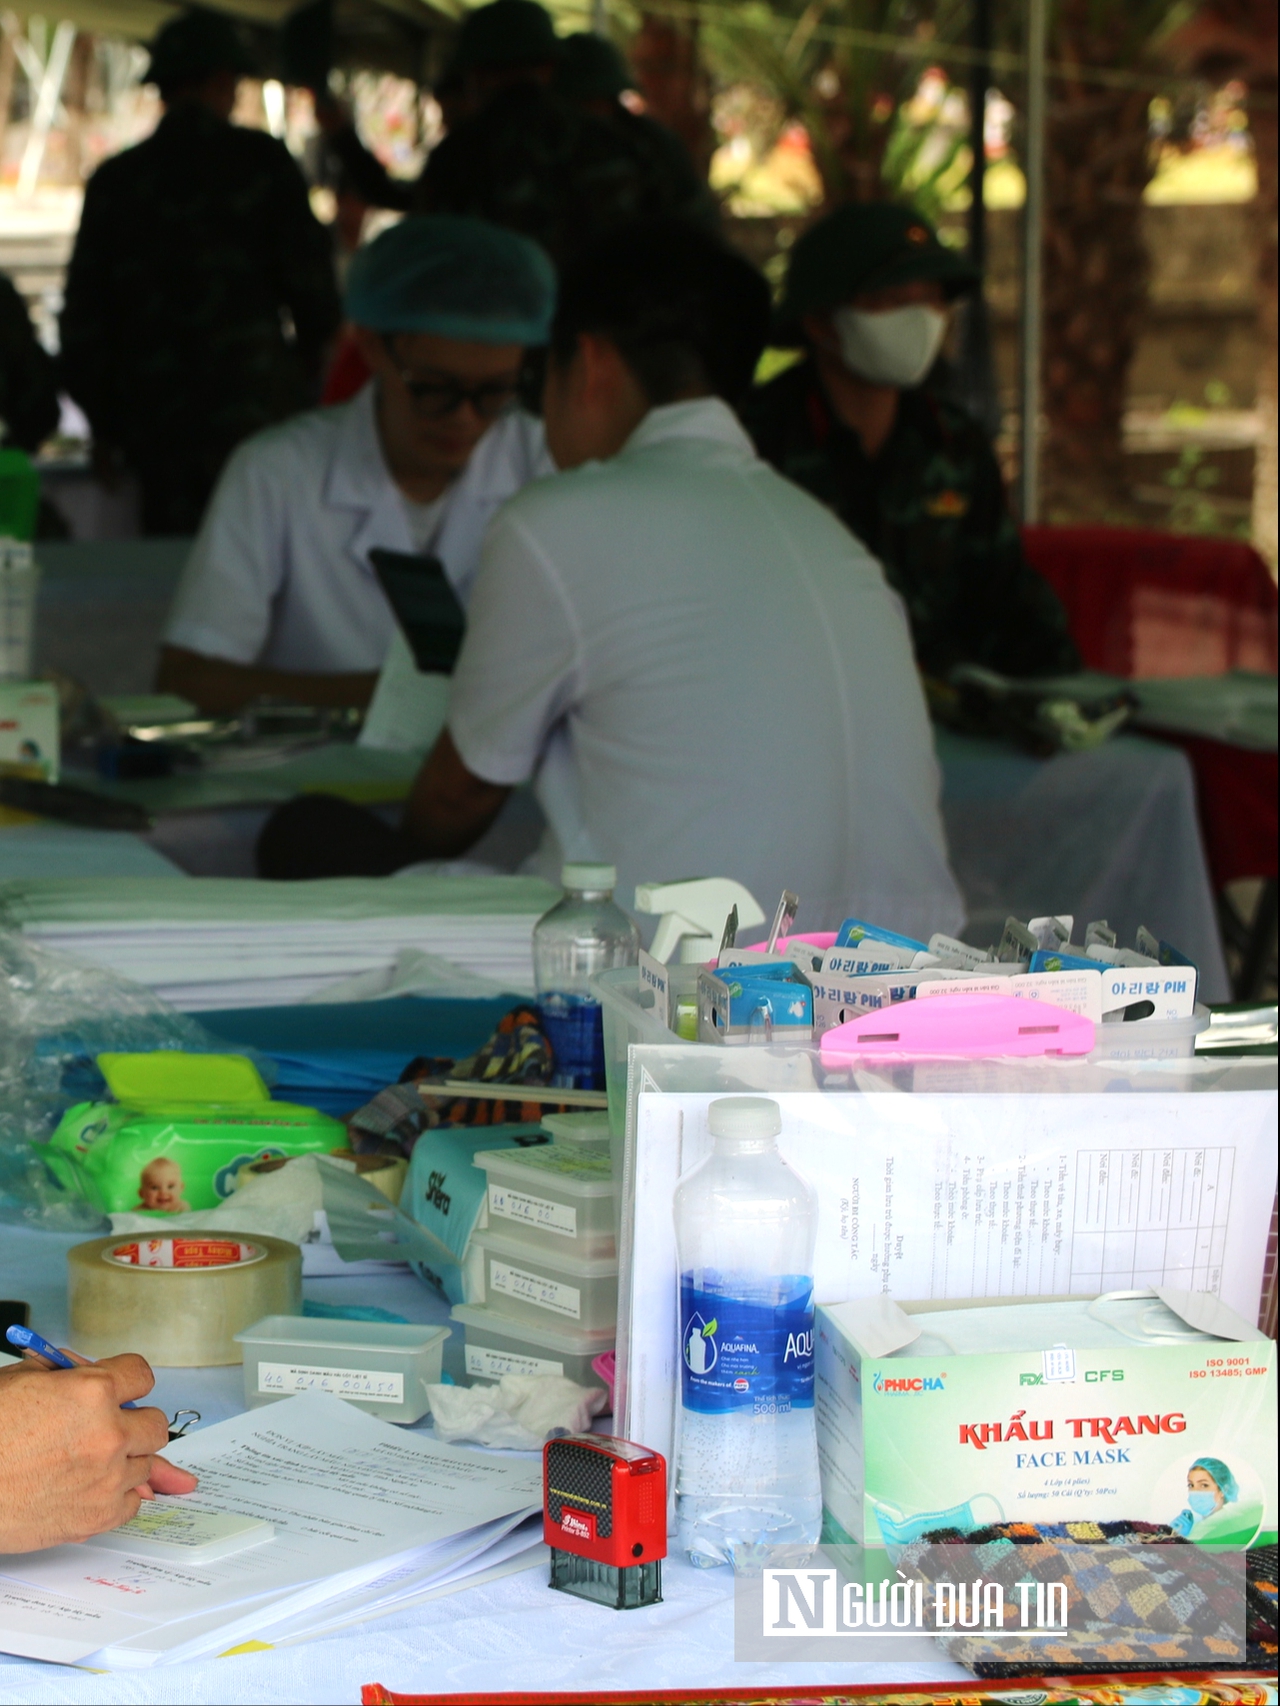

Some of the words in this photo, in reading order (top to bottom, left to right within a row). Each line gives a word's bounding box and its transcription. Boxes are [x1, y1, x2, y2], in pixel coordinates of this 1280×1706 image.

[1111, 981, 1160, 996] 아리랑
[885, 1156, 894, 1175] Thời
[1099, 1153, 1108, 1168] Nơi
[1131, 1153, 1139, 1168] Nơi
[1162, 1151, 1171, 1167] Nơi
[1193, 1151, 1202, 1166] Nơi
[851, 1177, 861, 1205] NGƯỜI
[884, 1177, 893, 1193] gian
[934, 1181, 943, 1200] Theo
[947, 1181, 957, 1200] Theo
[989, 1181, 998, 1200] Theo
[1002, 1181, 1011, 1199] Theo
[1030, 1180, 1039, 1199] Theo
[1043, 1180, 1053, 1199] Theo
[851, 1217, 860, 1242] CÔNG
[1000, 1219, 1010, 1245] khoán:
[1041, 1218, 1051, 1244] khoán:
[850, 1243, 860, 1260] TÁC
[894, 1235, 904, 1260] Duyệt
[870, 1253, 880, 1273] ngày
[720, 1341, 760, 1354] AQUAFINA
[783, 1328, 814, 1363] AQU
[1206, 1358, 1224, 1367] ISO
[1226, 1357, 1250, 1366] 9001
[1084, 1369, 1125, 1383] CFS
[1189, 1370, 1207, 1379] ISO
[1209, 1368, 1243, 1379] 13485;
[1245, 1366, 1268, 1376] GMP
[708, 1380, 727, 1388] makers
[884, 1376, 945, 1392] PHUCHA
[753, 1402, 777, 1414] 500
[778, 1401, 791, 1413] ml
[958, 1410, 1054, 1449] KHẨU
[1065, 1412, 1187, 1445] TRANG
[1015, 1452, 1067, 1469] FACE
[1072, 1448, 1131, 1466] MASK
[1049, 1478, 1063, 1488] Lớp
[1017, 1490, 1027, 1500] Số
[1028, 1489, 1051, 1501] lượng:
[1051, 1490, 1060, 1498] 50
[1061, 1489, 1073, 1498] Cái
